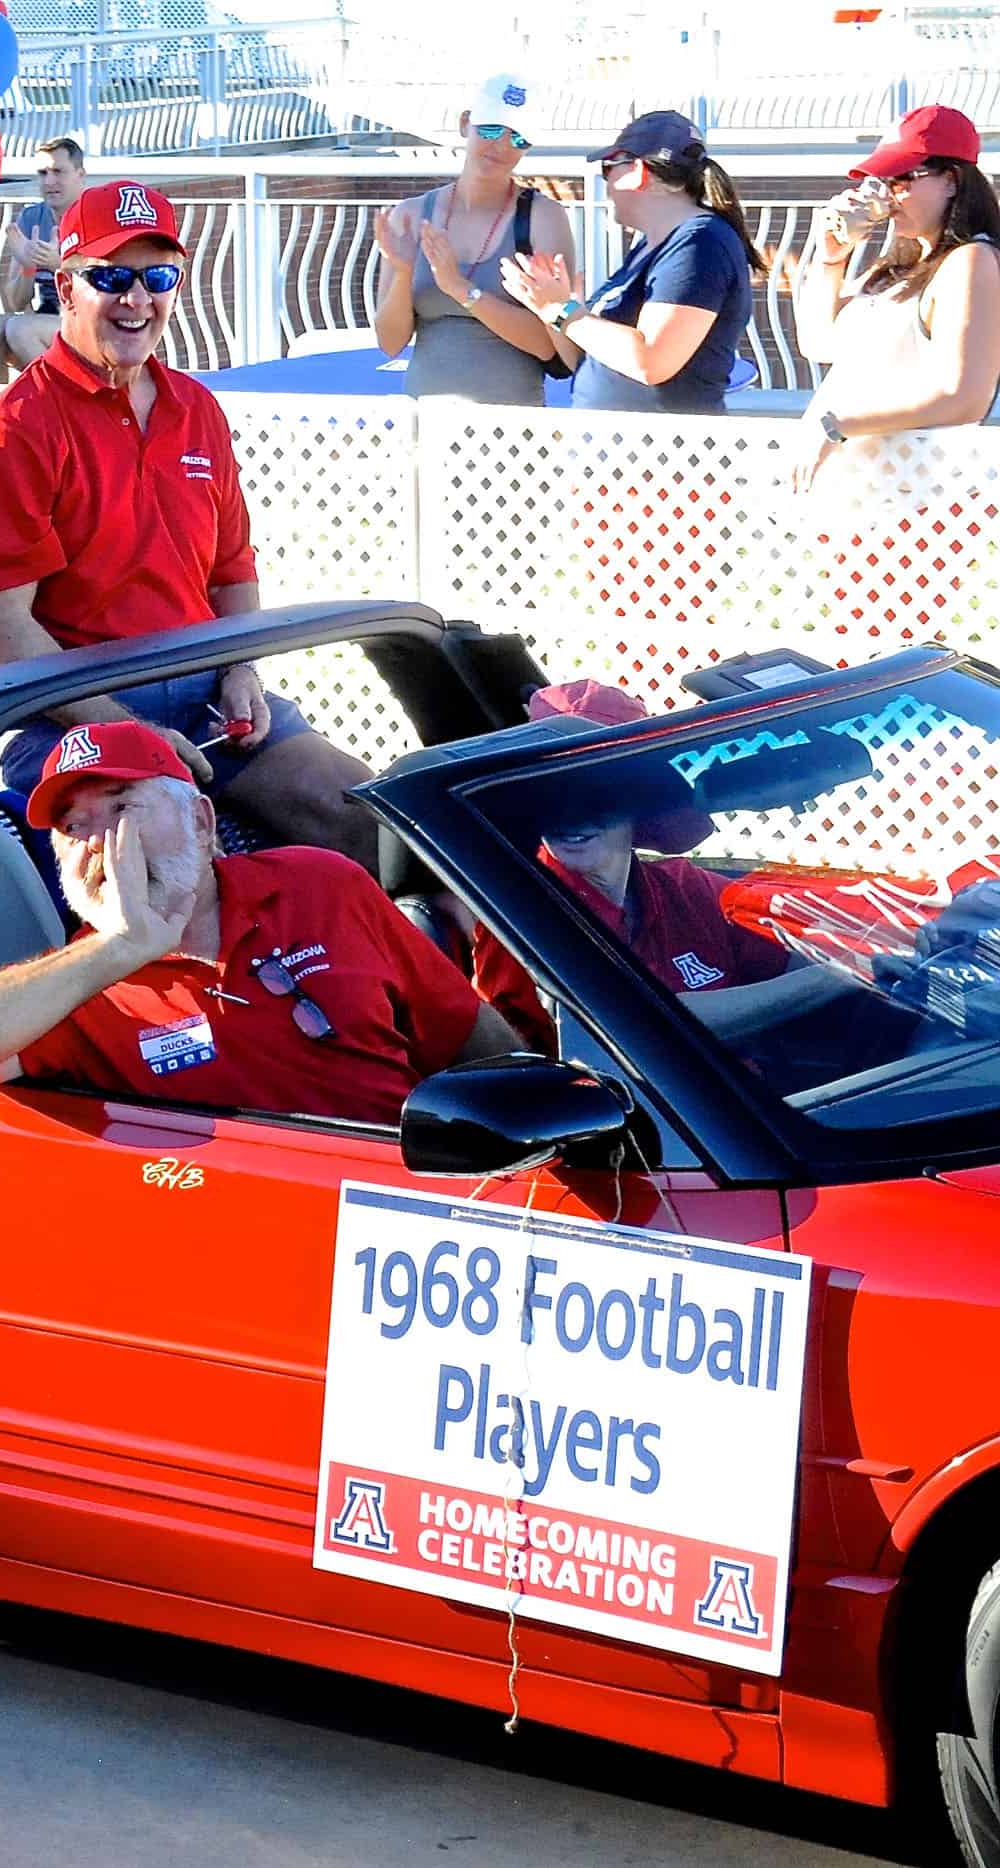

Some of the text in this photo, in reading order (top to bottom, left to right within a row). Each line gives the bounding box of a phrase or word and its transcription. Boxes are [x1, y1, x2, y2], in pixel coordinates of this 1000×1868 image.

[115, 186, 158, 222] A
[56, 726, 102, 774] A
[671, 951, 725, 989] A
[160, 1036, 194, 1053] DUCKS
[354, 1240, 785, 1391] 1968 Football
[433, 1363, 662, 1497] Players
[332, 1476, 396, 1554] A
[418, 1492, 677, 1579] HOMECOMING
[416, 1530, 675, 1616] CELEBRATION
[693, 1555, 767, 1638] A
